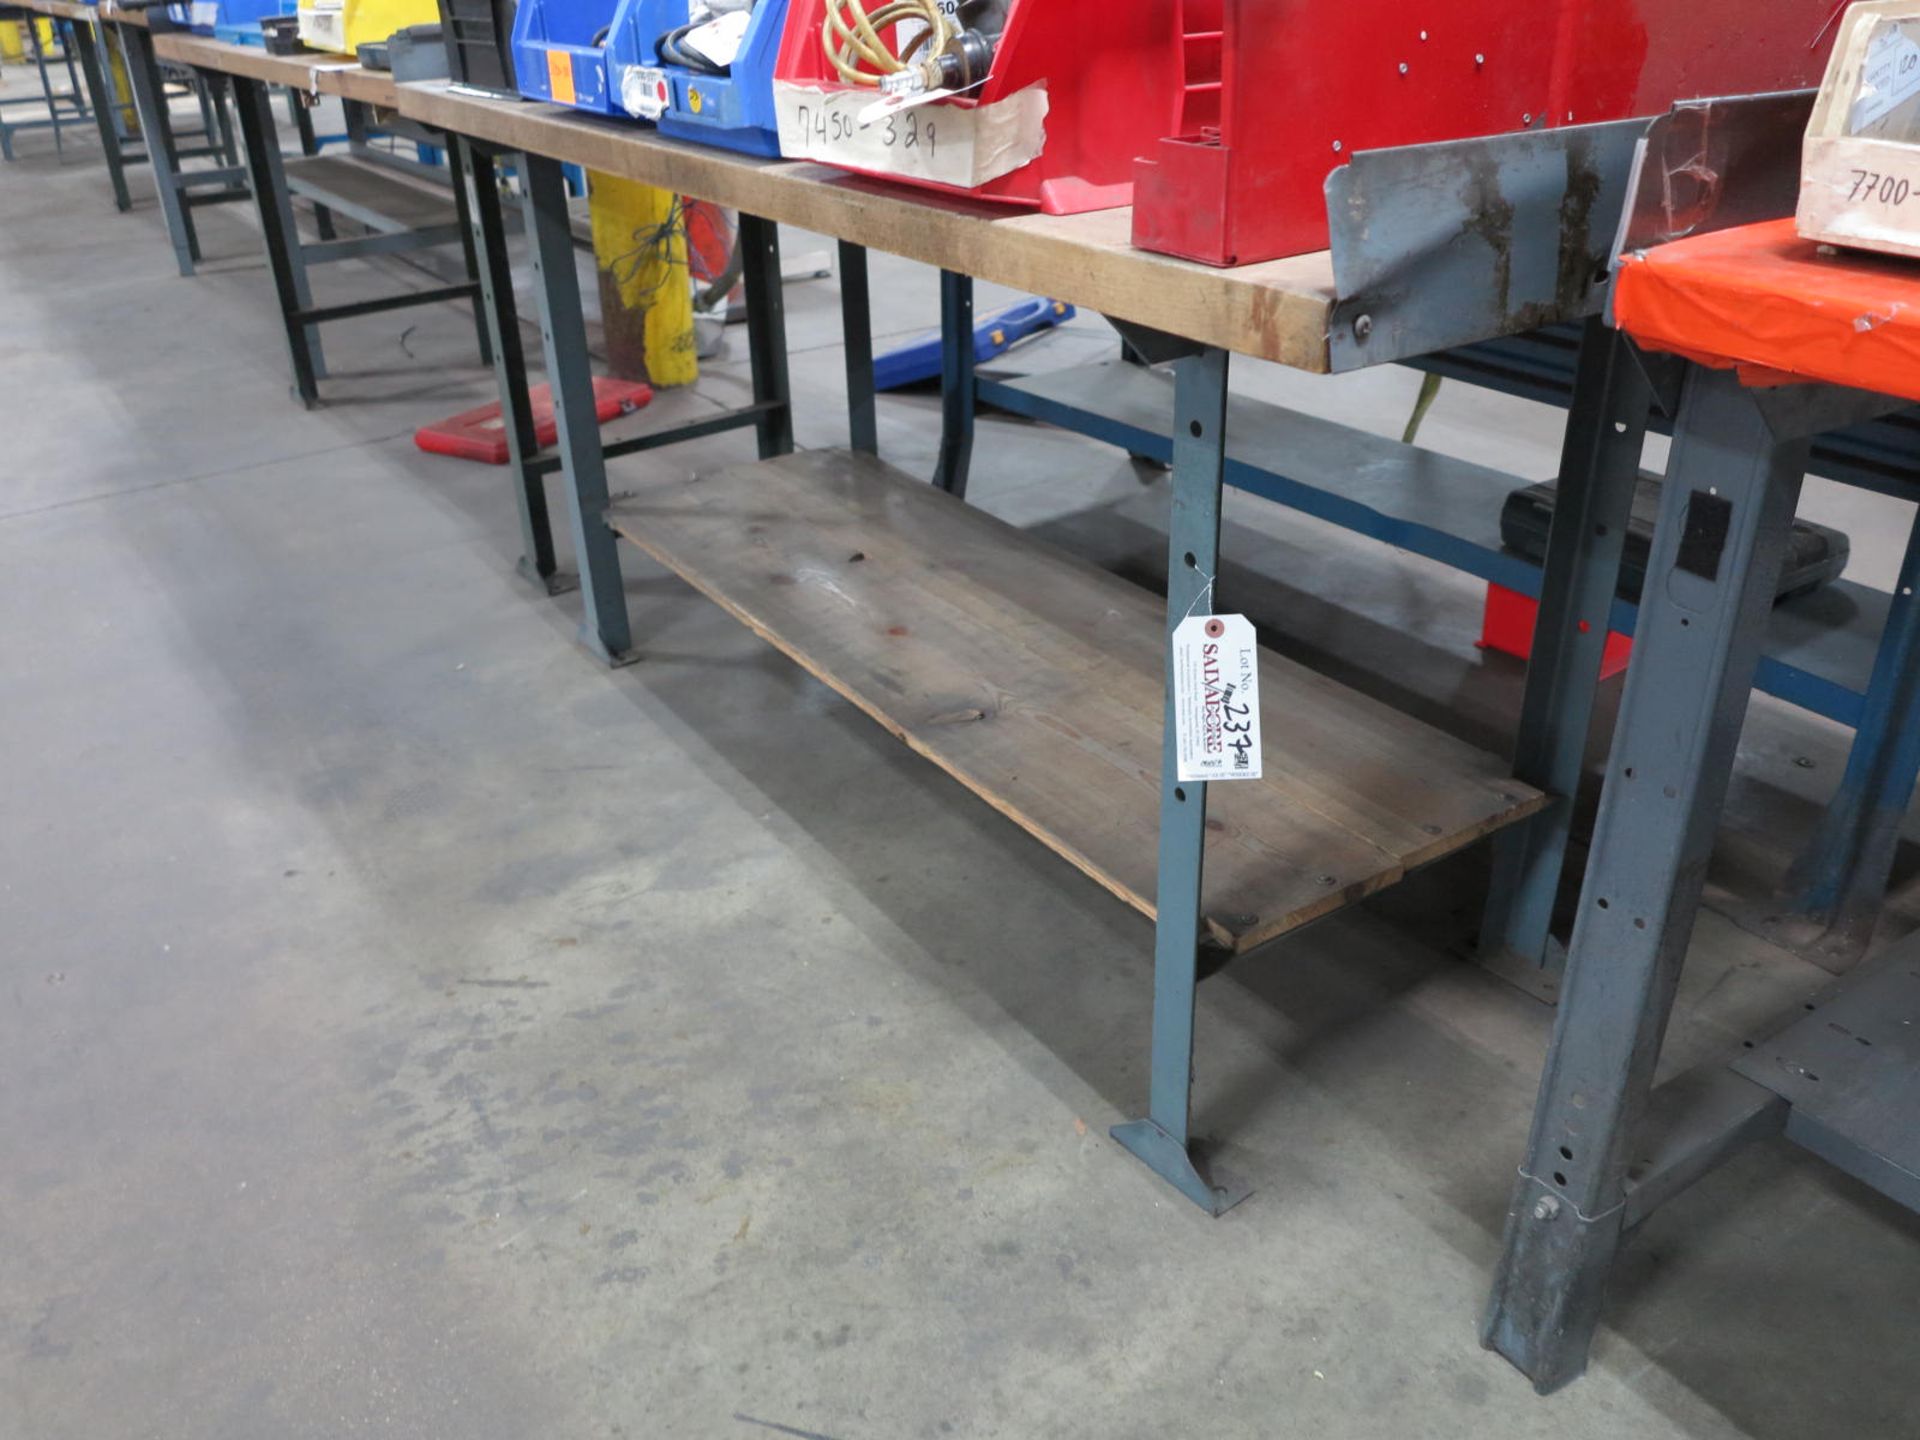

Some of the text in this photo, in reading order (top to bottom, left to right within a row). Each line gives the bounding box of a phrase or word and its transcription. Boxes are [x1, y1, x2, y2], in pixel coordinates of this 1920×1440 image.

[1239, 648, 1253, 694] Lot No.
[1223, 703, 1253, 753] 237
